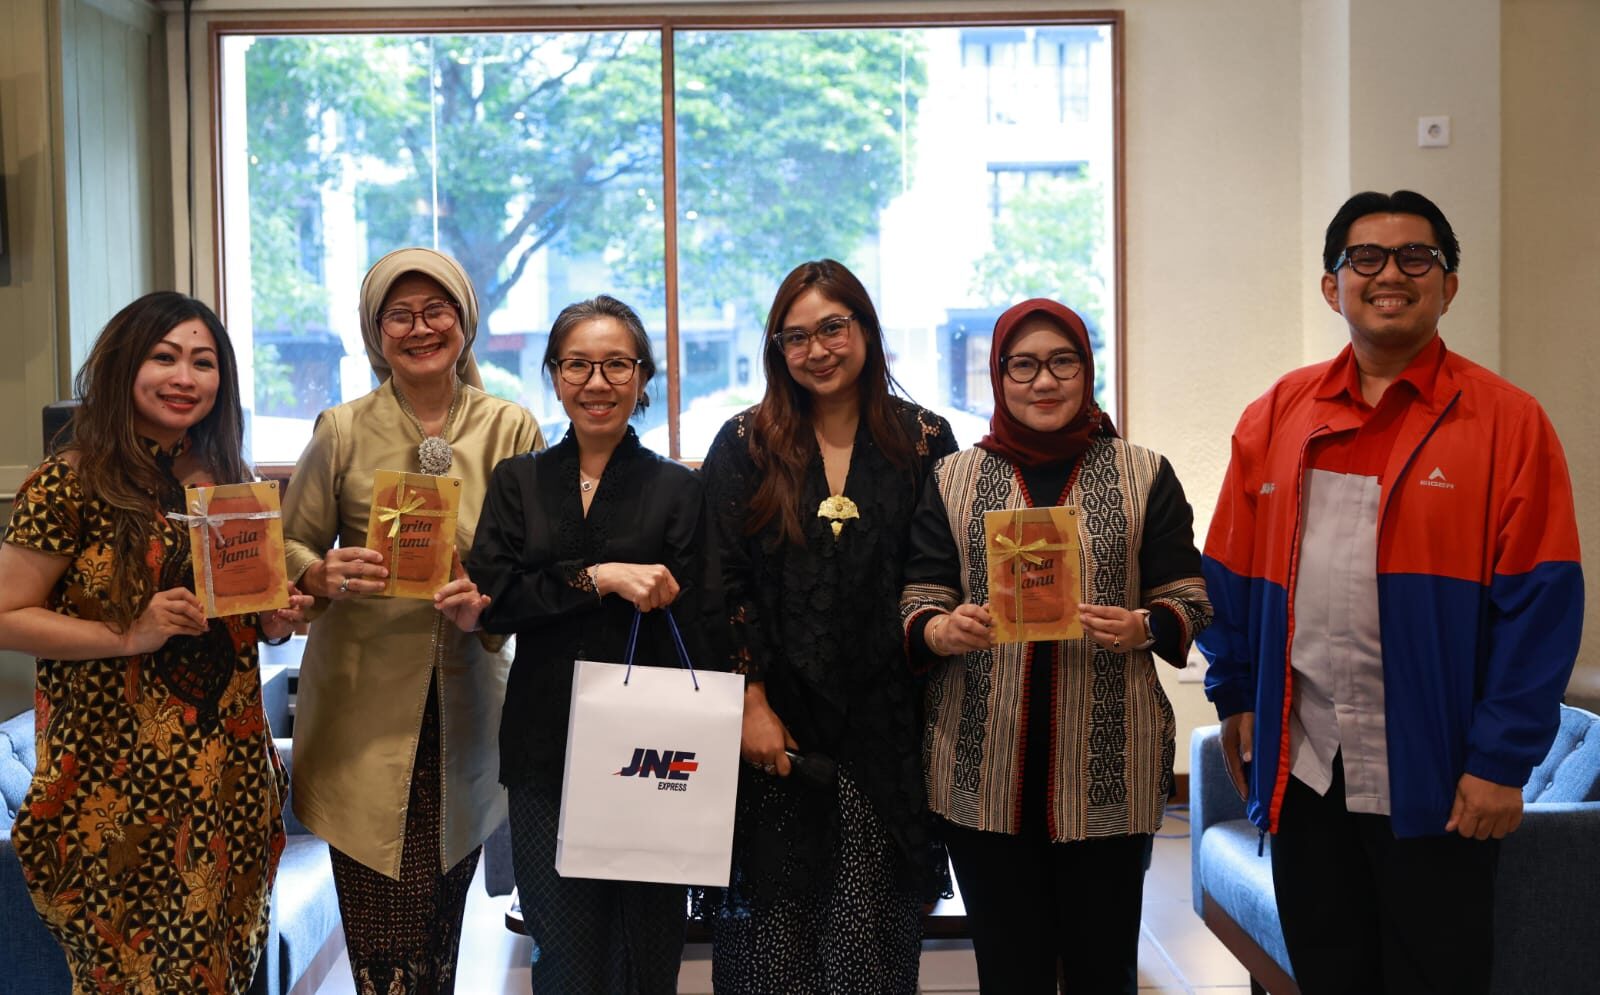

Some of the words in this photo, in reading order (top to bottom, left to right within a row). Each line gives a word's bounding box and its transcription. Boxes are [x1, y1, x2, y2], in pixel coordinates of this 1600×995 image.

[399, 520, 432, 533] erita
[217, 547, 259, 569] Jamu
[1021, 574, 1055, 589] amu
[612, 747, 699, 781] JNE
[657, 781, 687, 792] EXPRESS
